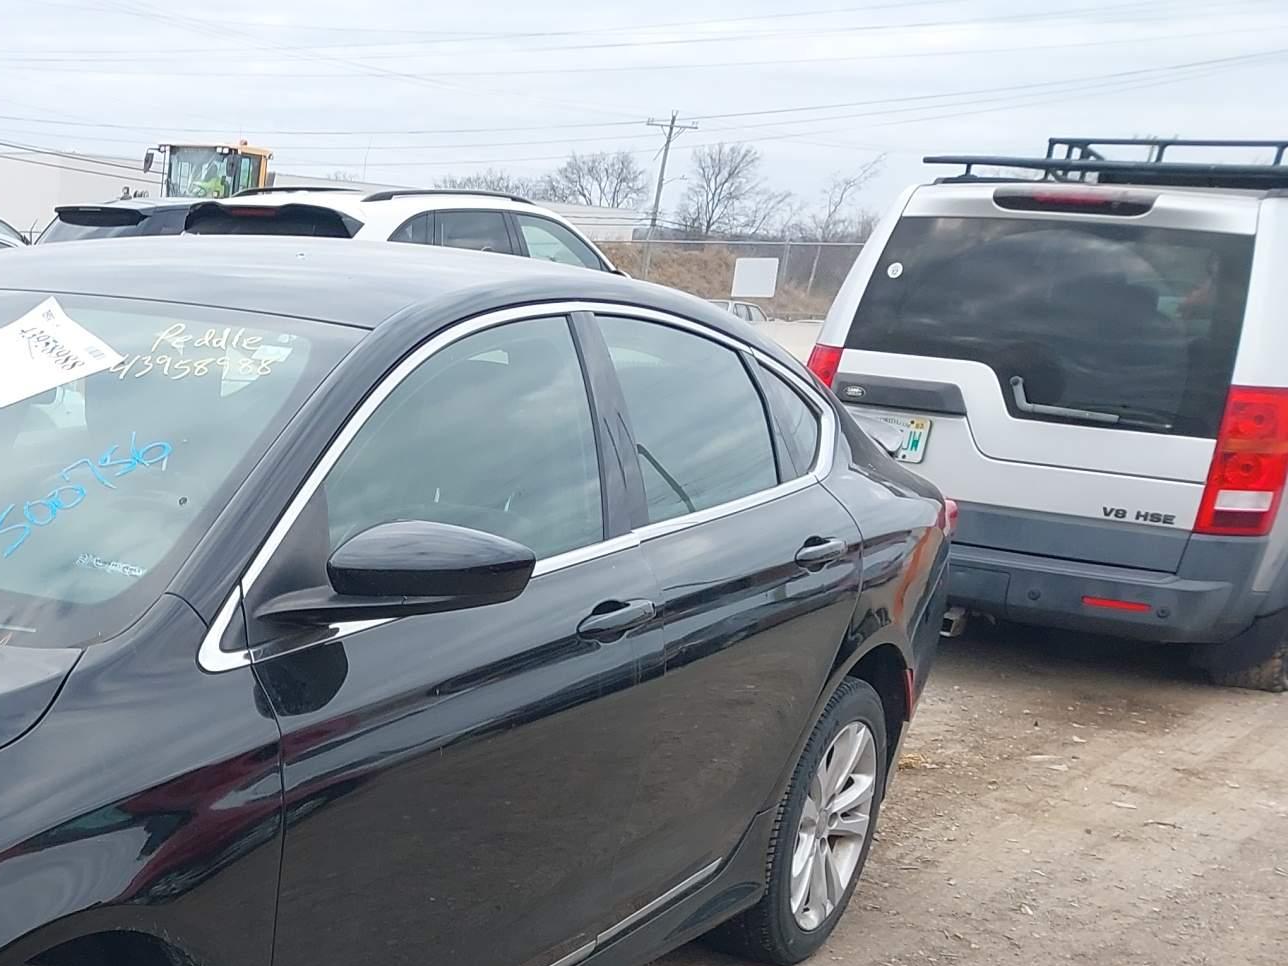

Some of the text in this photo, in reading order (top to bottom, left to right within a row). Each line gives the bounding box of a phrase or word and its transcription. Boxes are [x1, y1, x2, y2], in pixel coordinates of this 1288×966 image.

[151, 323, 263, 351] Peddle
[111, 354, 272, 380] 43958988
[1102, 506, 1176, 525] V8 HSE
